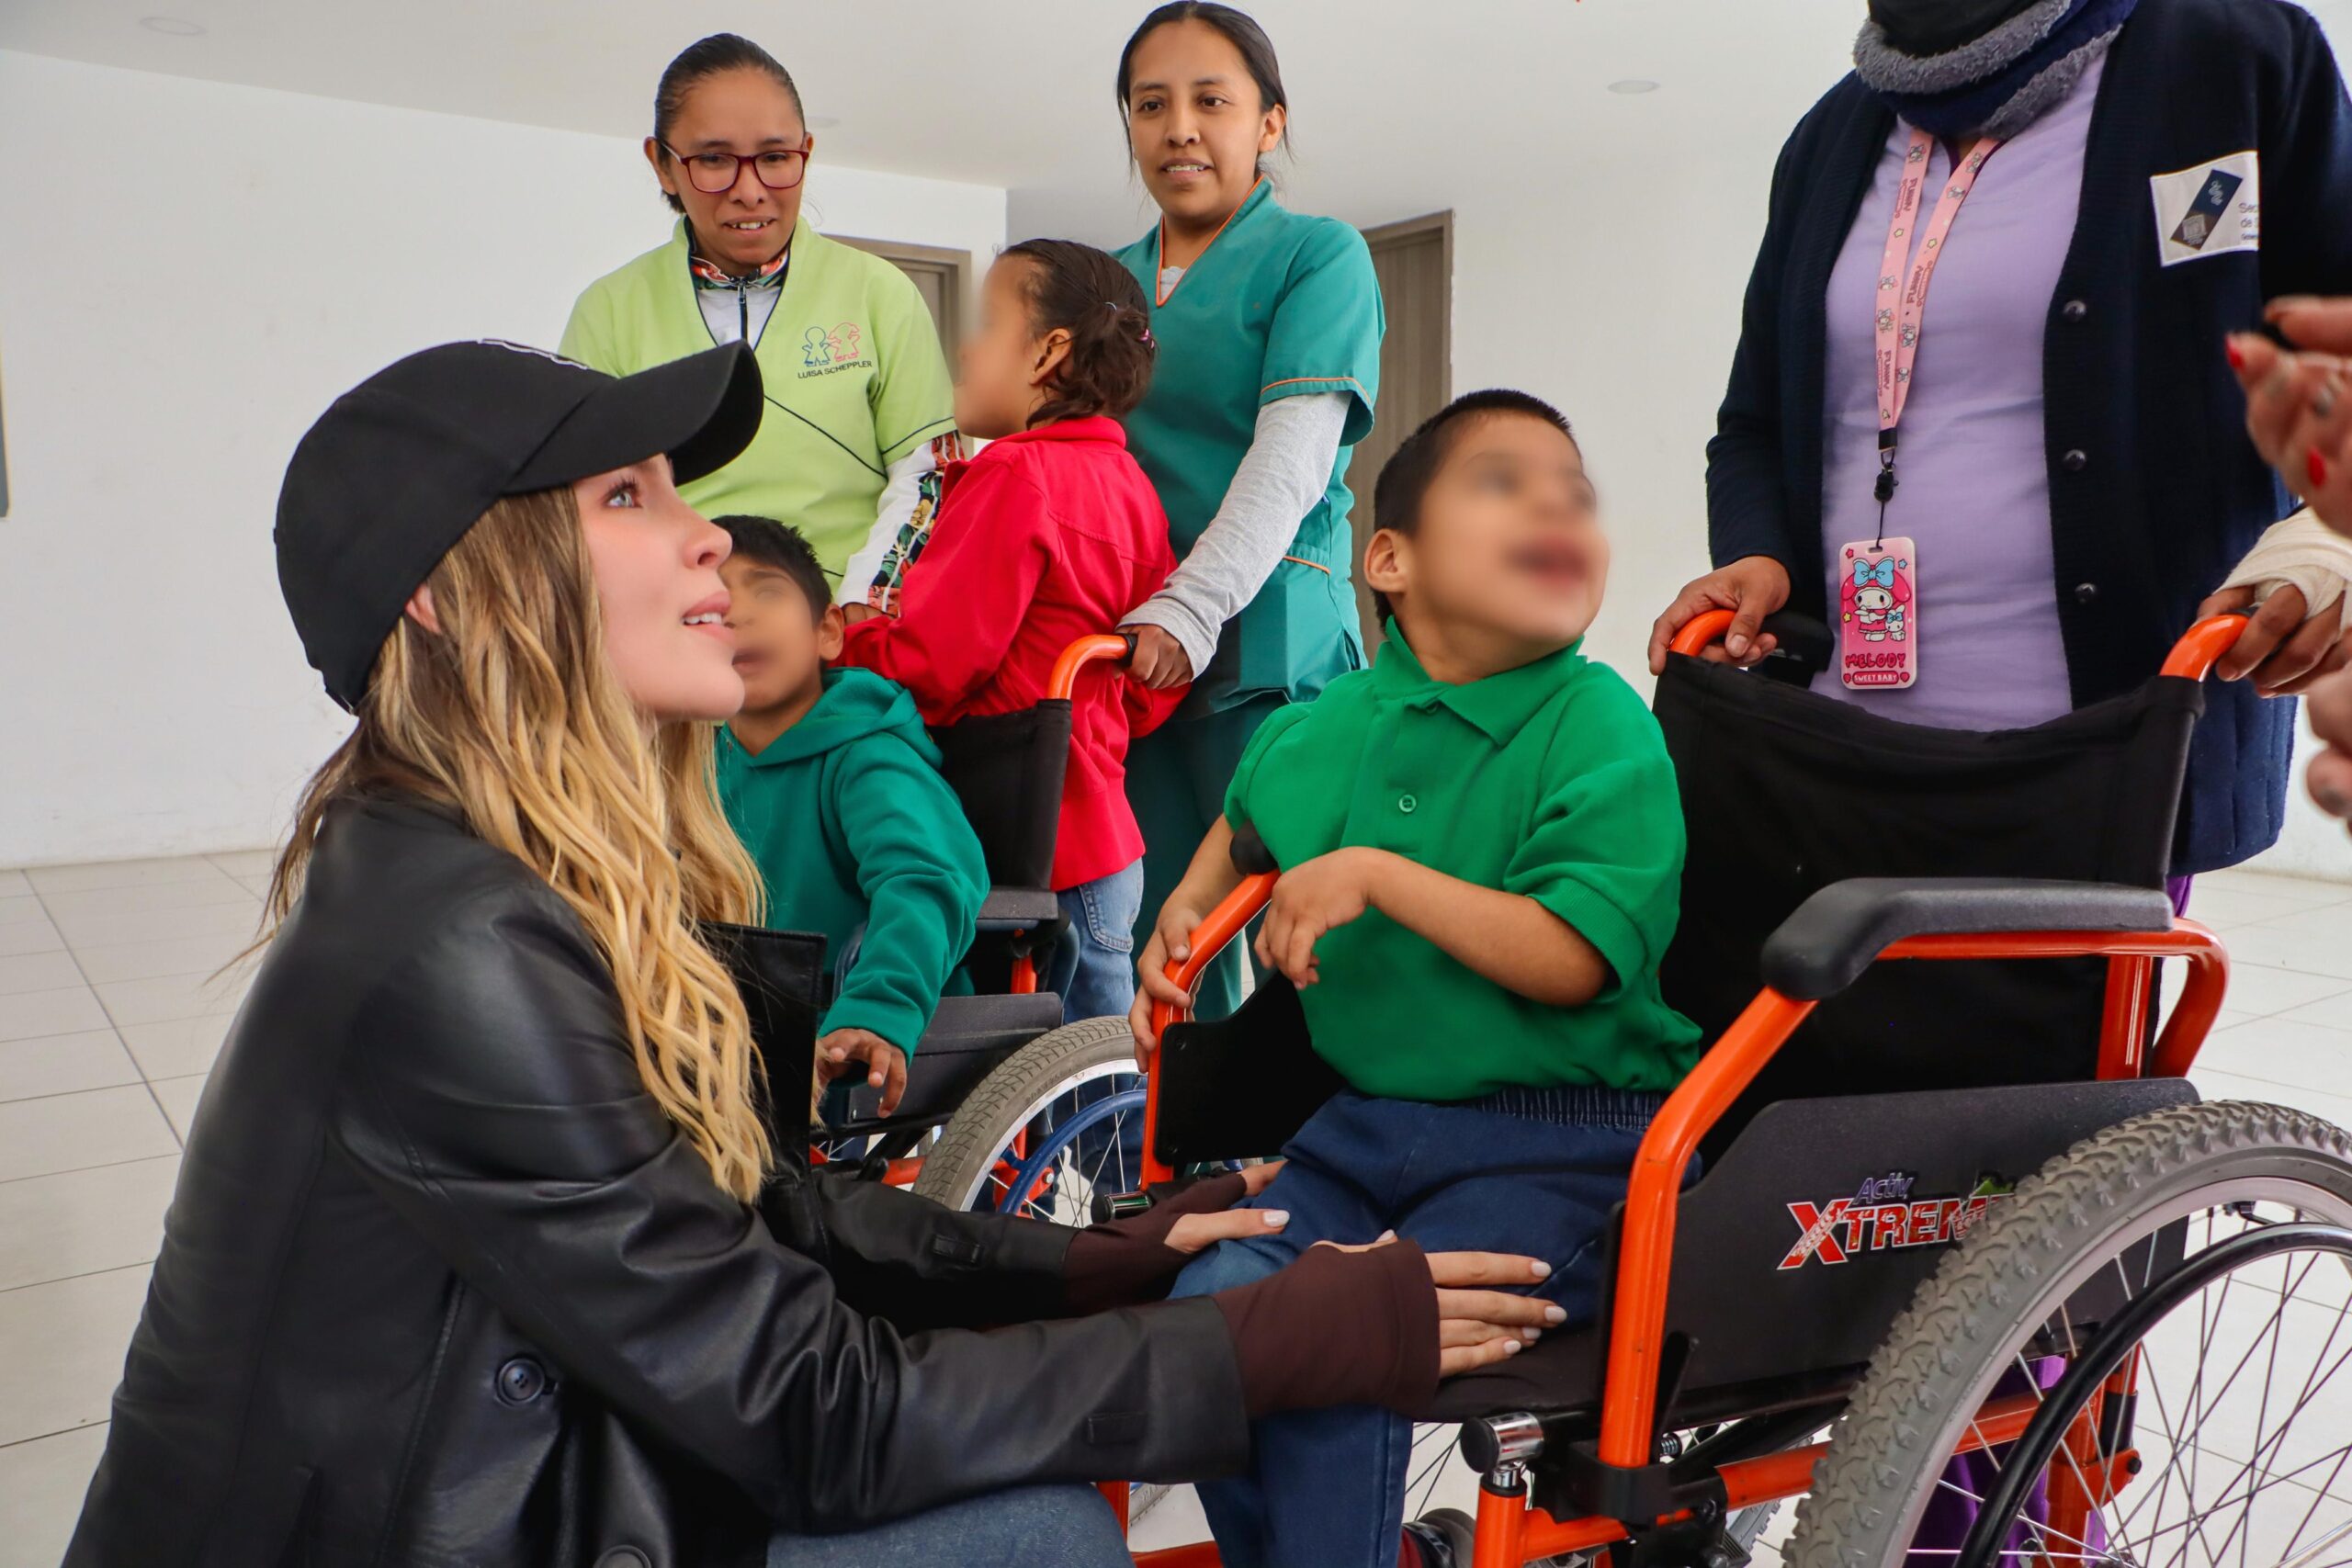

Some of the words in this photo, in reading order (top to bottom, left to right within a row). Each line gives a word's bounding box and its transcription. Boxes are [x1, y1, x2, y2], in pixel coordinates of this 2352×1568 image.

[797, 369, 823, 379] LUISA
[824, 360, 873, 375] SCHEPPLER
[1845, 652, 1906, 669] MELODY
[1854, 674, 1876, 682] SWEET
[1877, 673, 1897, 682] BABY
[1777, 1193, 2008, 1270] XTREM
